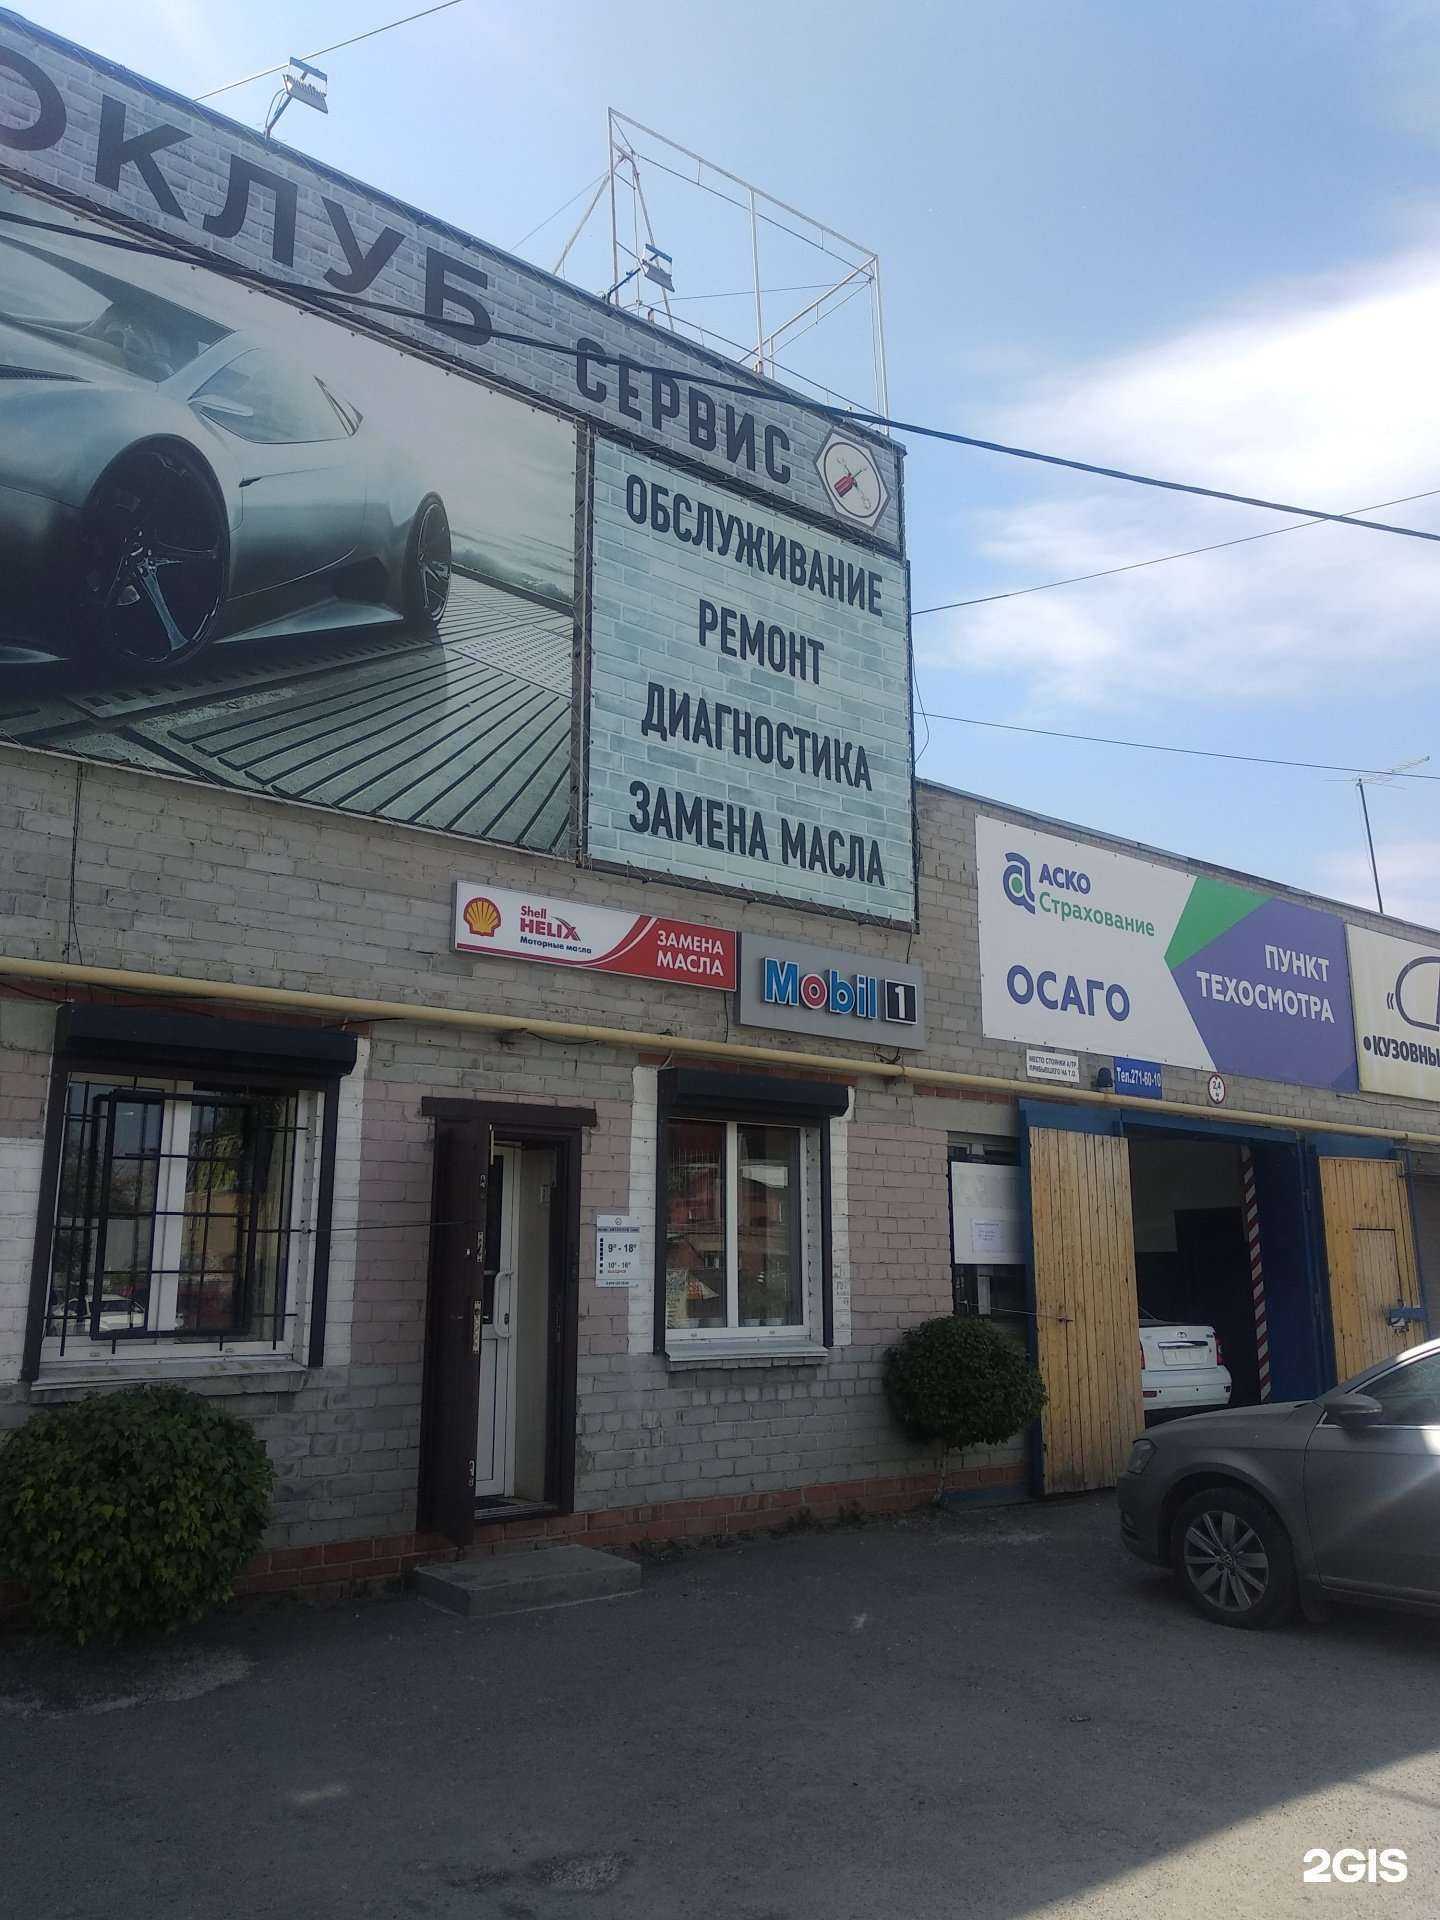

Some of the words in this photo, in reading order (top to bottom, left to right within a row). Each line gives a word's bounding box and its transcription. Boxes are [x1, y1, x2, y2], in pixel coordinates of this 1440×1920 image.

[576, 337, 791, 484] СЕРВИС
[626, 474, 883, 617] ОБСЛУЖИВАНИЕ
[699, 599, 825, 685] РЕМОНТ
[641, 682, 872, 791] ДИАГНОСТИКА
[629, 780, 769, 860] ЗАМЕНА
[780, 818, 885, 886] МАСЛА
[1039, 863, 1091, 894] АСКО
[520, 905, 547, 919] Shell
[520, 917, 580, 942] HELIX
[1039, 891, 1155, 937] Страхование
[520, 936, 564, 950] Моторные
[566, 945, 592, 954] масла
[656, 950, 724, 976] МАСЛА
[657, 930, 724, 955] ЗАМЕНА
[1264, 944, 1330, 983] ПУНКТ
[762, 957, 877, 1019] Mobil
[1006, 964, 1131, 1022] ОСАГО
[1197, 970, 1335, 1024] ТЕХОСМОТРА
